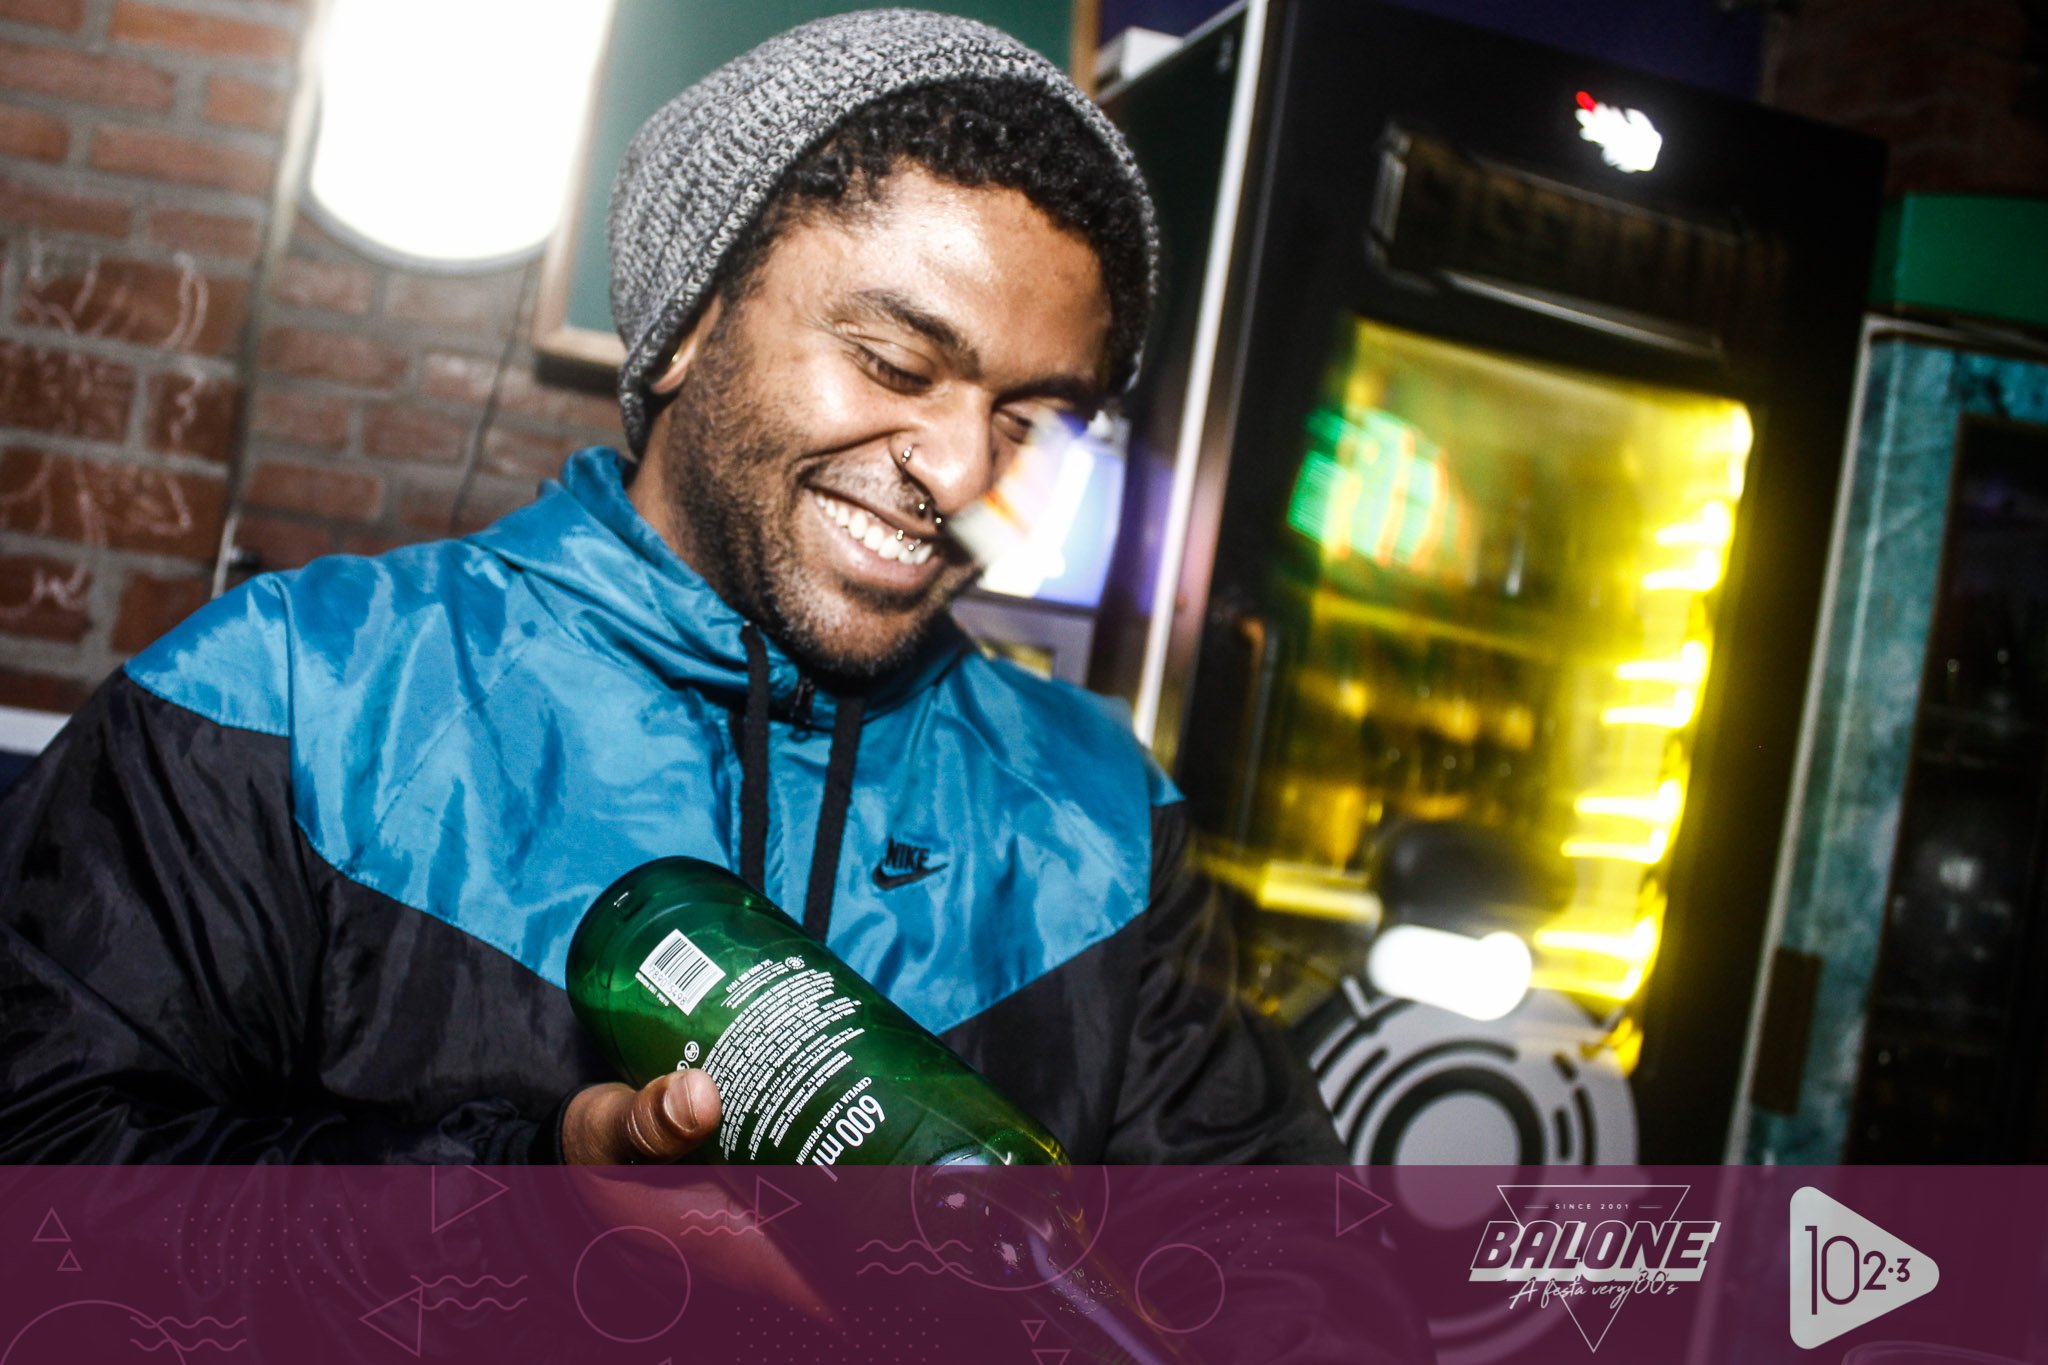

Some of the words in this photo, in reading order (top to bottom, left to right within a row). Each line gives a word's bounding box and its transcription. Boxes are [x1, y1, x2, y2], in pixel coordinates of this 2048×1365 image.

[885, 837, 930, 872] NIKE
[646, 965, 668, 988] 7890
[666, 983, 688, 1006] 5498
[792, 1085, 818, 1115] SUPERVISÃO
[839, 1076, 873, 1104] CERVEJA
[819, 1102, 844, 1128] LAGER
[835, 1094, 886, 1147] 600
[795, 1125, 823, 1166] PREMIUM
[811, 1132, 845, 1182] ml
